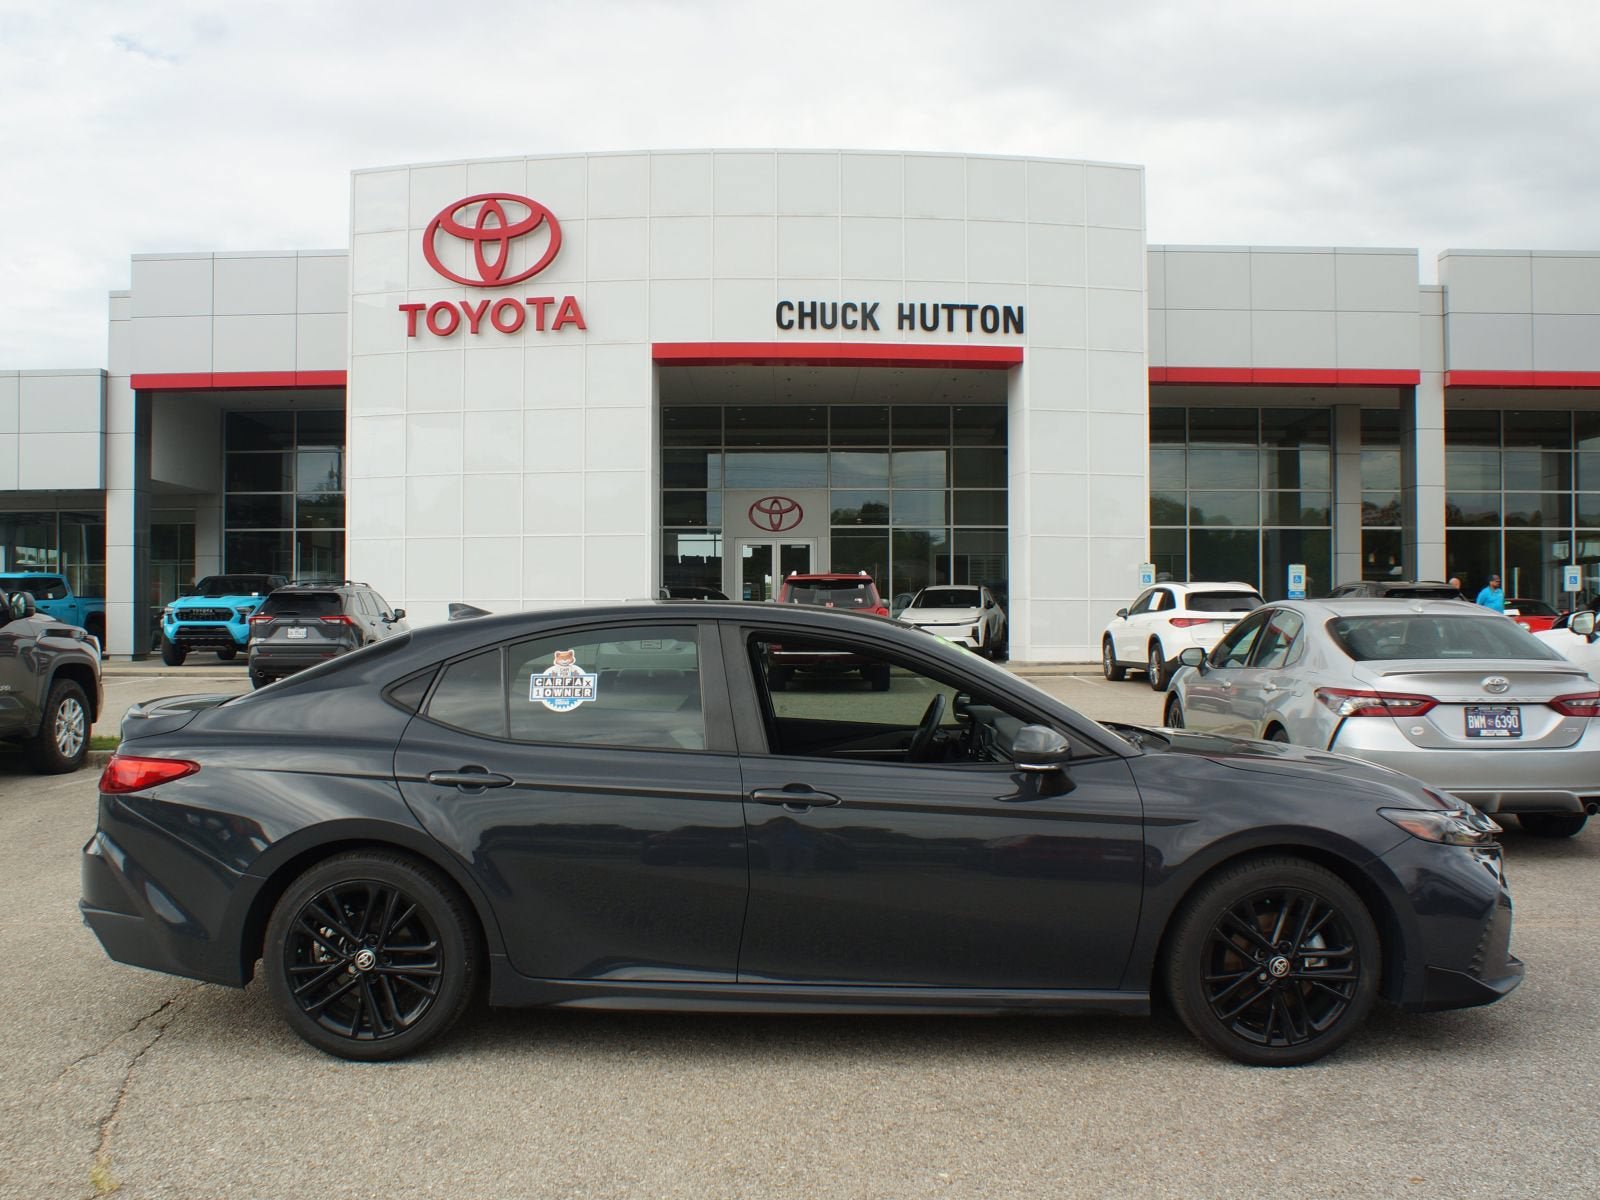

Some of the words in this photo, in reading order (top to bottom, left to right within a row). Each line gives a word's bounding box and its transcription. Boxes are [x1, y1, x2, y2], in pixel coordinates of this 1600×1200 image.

[399, 295, 587, 337] TOYOTA
[776, 300, 880, 331] CHUCK
[898, 302, 1024, 334] HUTTON
[535, 678, 592, 687] CARFAX
[1495, 715, 1519, 729] 6390
